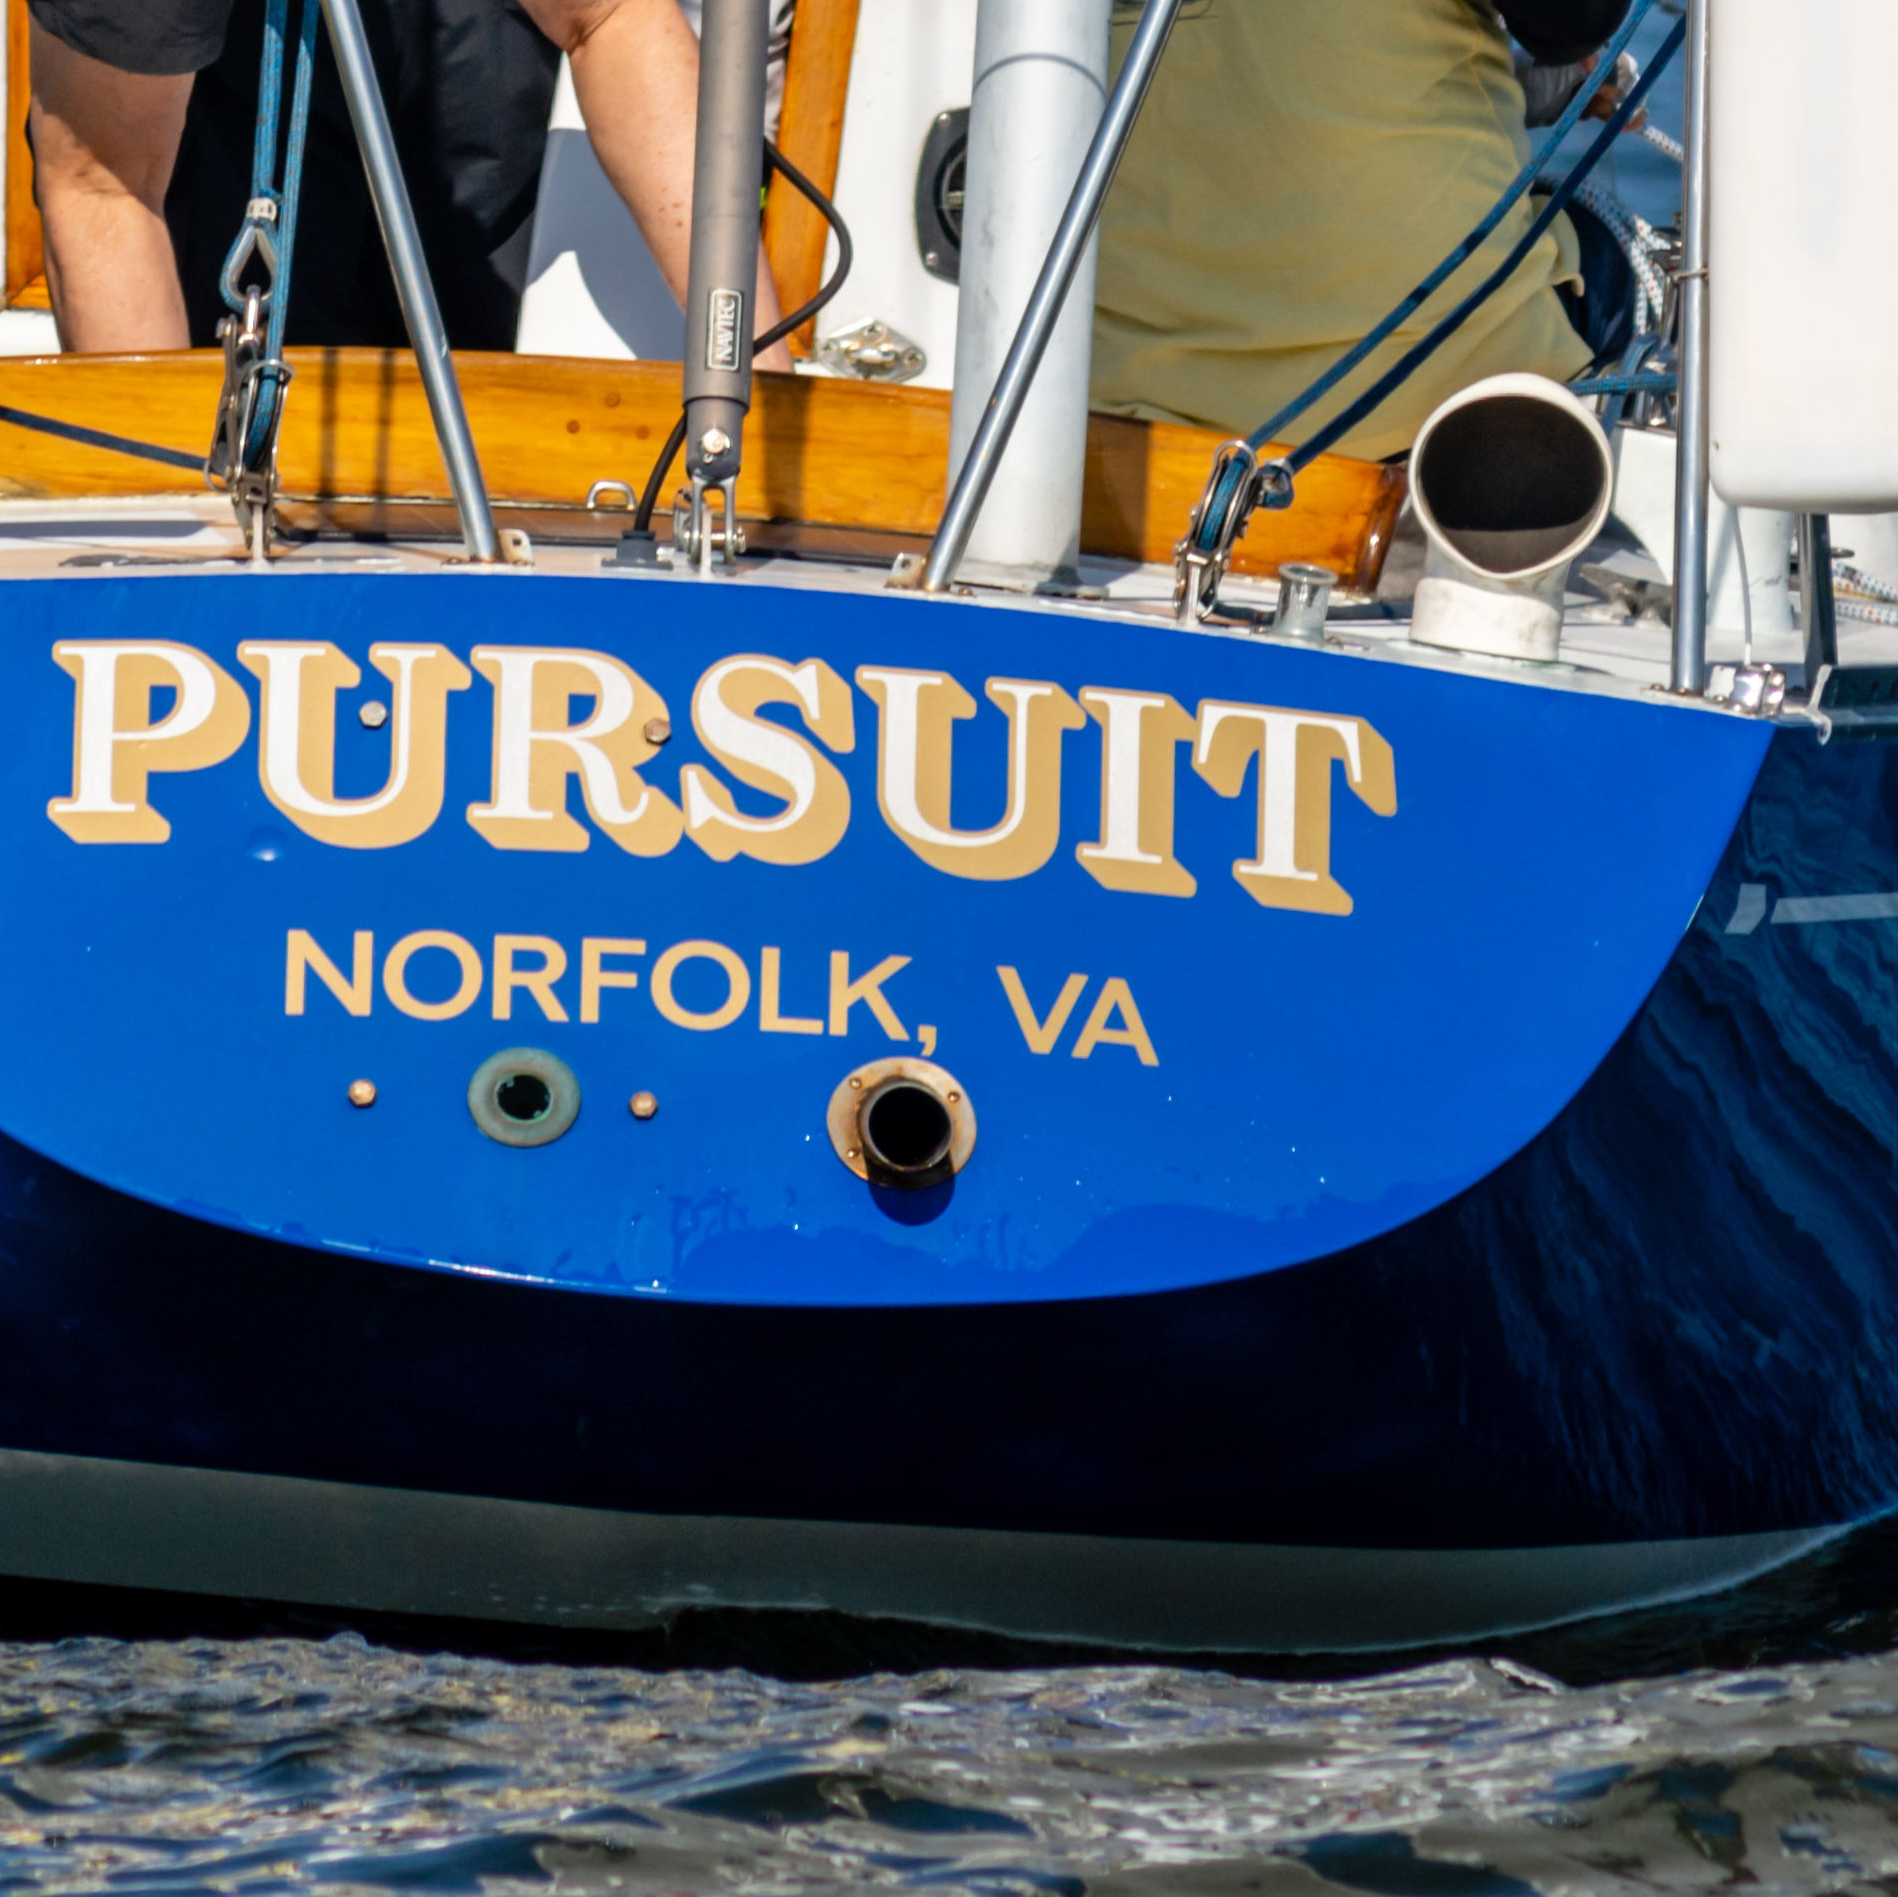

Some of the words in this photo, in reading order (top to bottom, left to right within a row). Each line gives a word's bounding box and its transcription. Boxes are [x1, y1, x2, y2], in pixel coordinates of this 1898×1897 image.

[716, 298, 736, 362] NAVTEC
[47, 638, 1398, 917] PURSUIT
[284, 928, 943, 1057] NORFOLK,
[996, 964, 1161, 1068] VA
